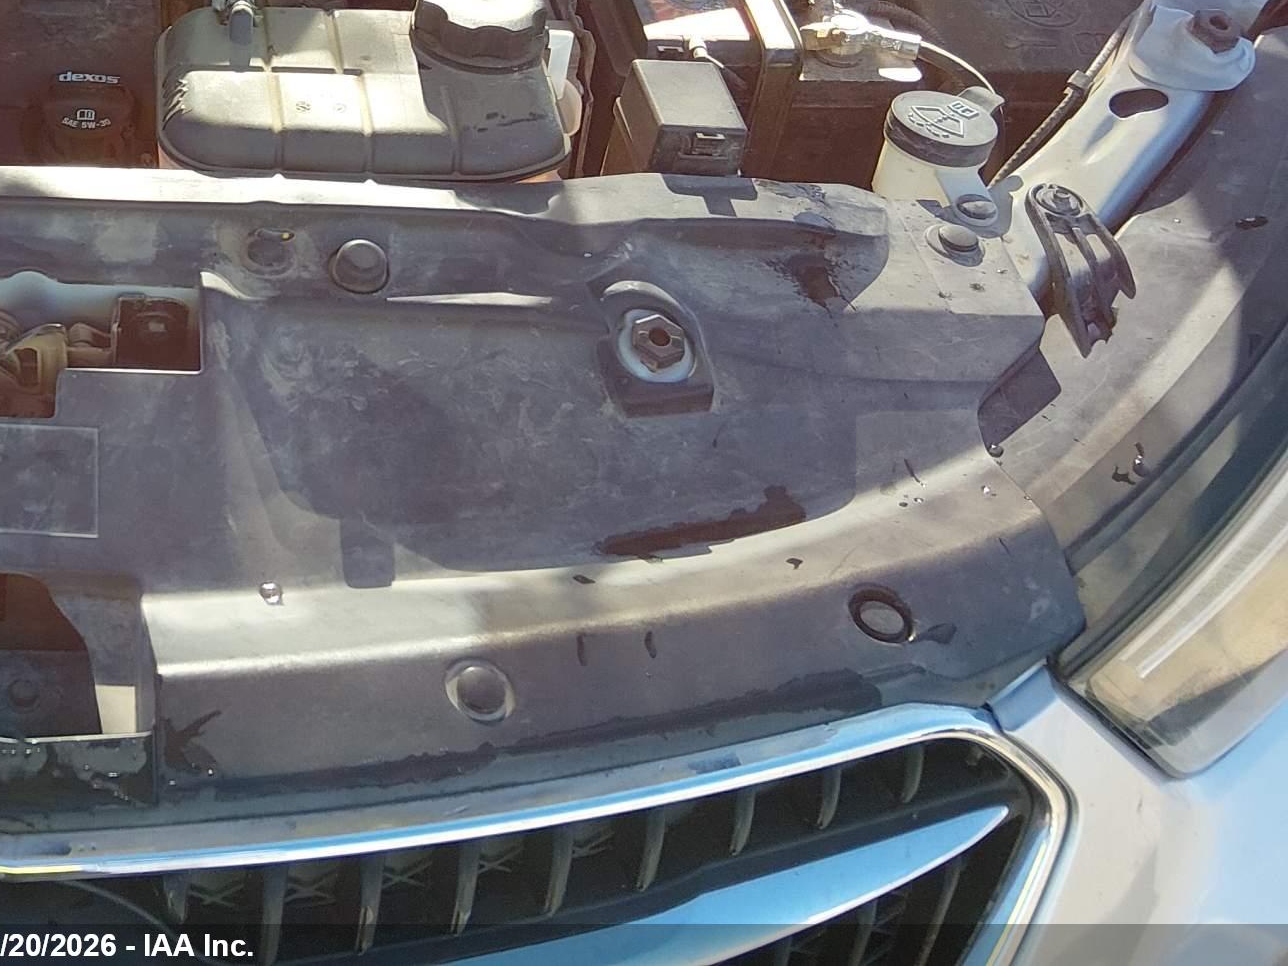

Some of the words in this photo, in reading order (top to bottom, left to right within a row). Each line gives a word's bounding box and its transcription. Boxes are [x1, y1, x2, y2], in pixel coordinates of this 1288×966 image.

[58, 71, 120, 84] dexos
[61, 117, 79, 128] SAE
[81, 118, 111, 129] 5W-30
